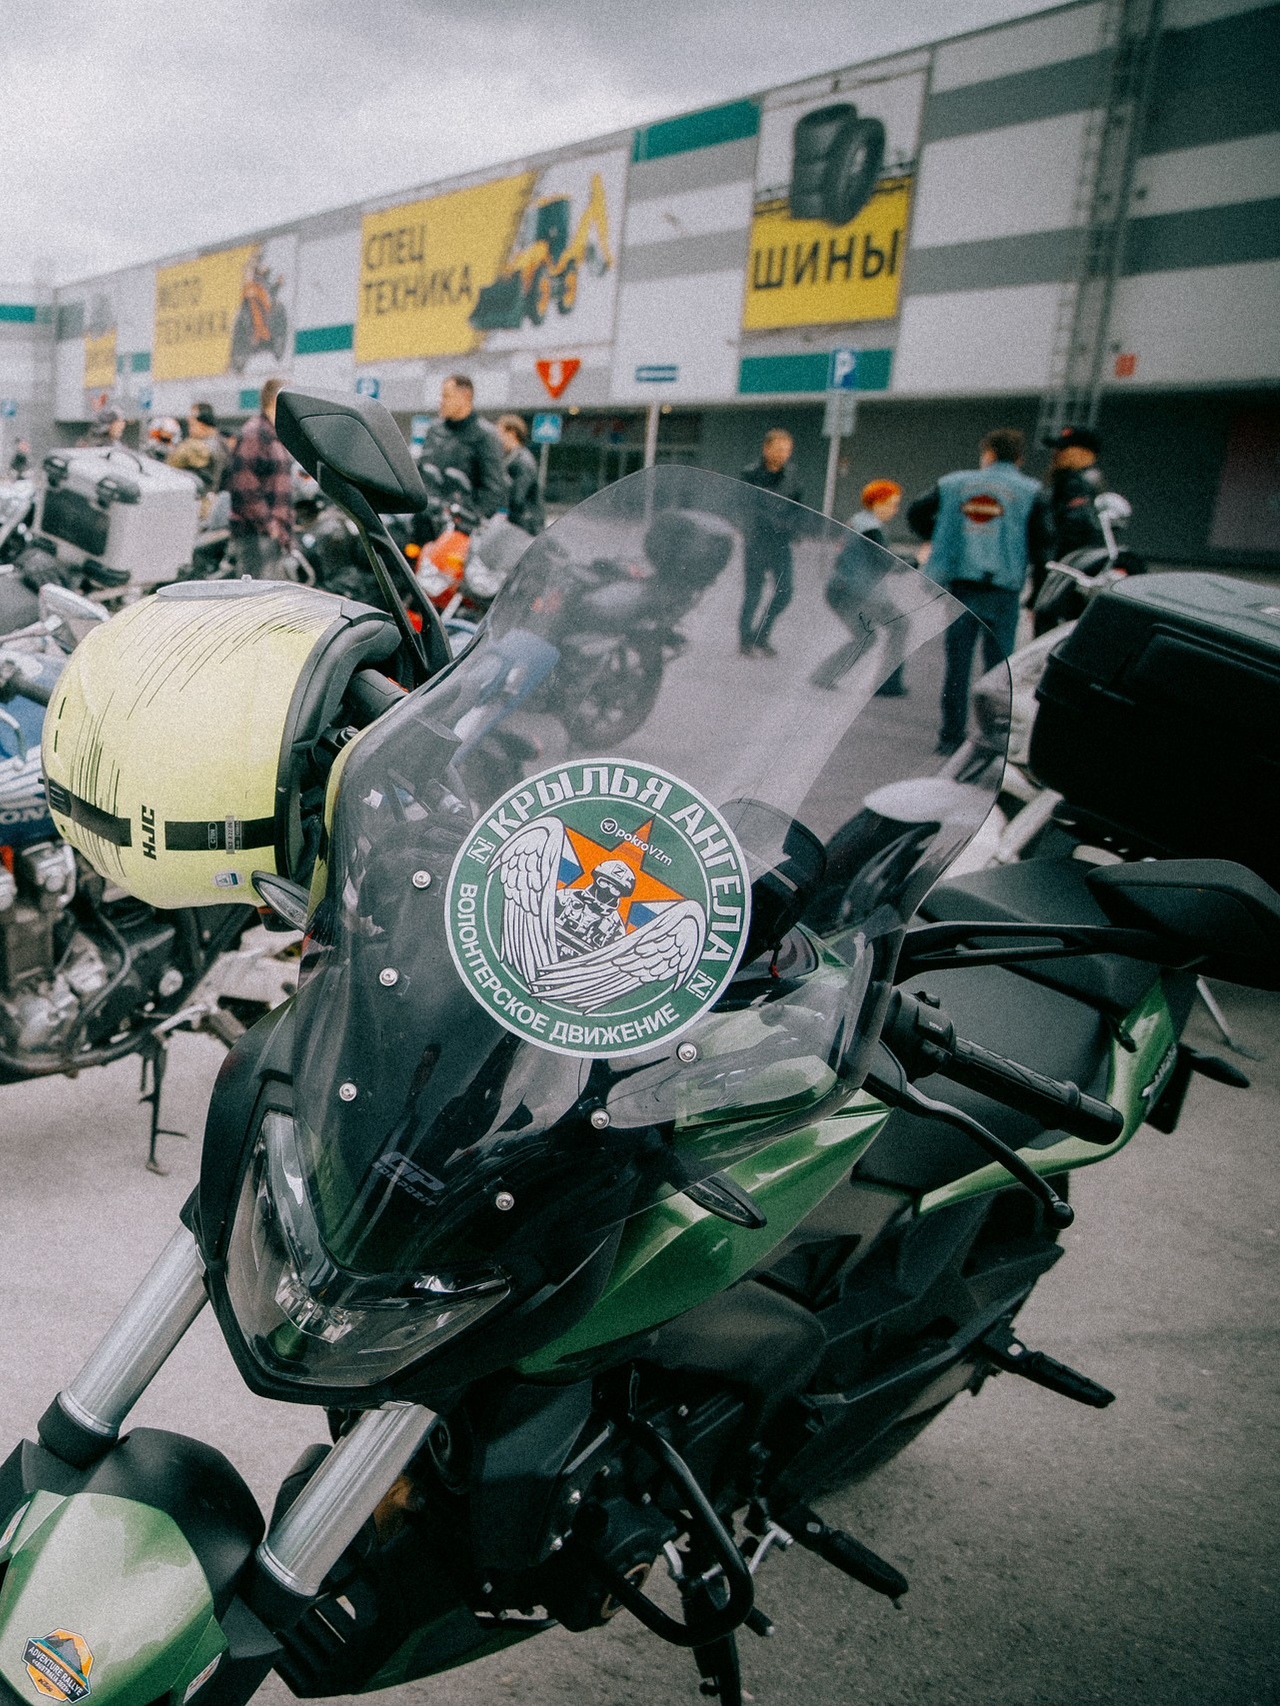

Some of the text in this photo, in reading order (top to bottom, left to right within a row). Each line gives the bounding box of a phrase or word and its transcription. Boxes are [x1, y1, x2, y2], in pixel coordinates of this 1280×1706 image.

[365, 223, 425, 270] СПЕЦ
[753, 228, 900, 290] ШИНЫ
[363, 262, 473, 316] ТЕХНИКА
[833, 351, 856, 386] P
[141, 804, 157, 861] HJC
[486, 766, 742, 962] КРЫЛЬЯ АНГЕЛА
[457, 883, 680, 1045] ВОЛОНТЕРСКОЕ ДВИЖЕНИЕ
[28, 1646, 84, 1697] ADVENTURE RALLYE
